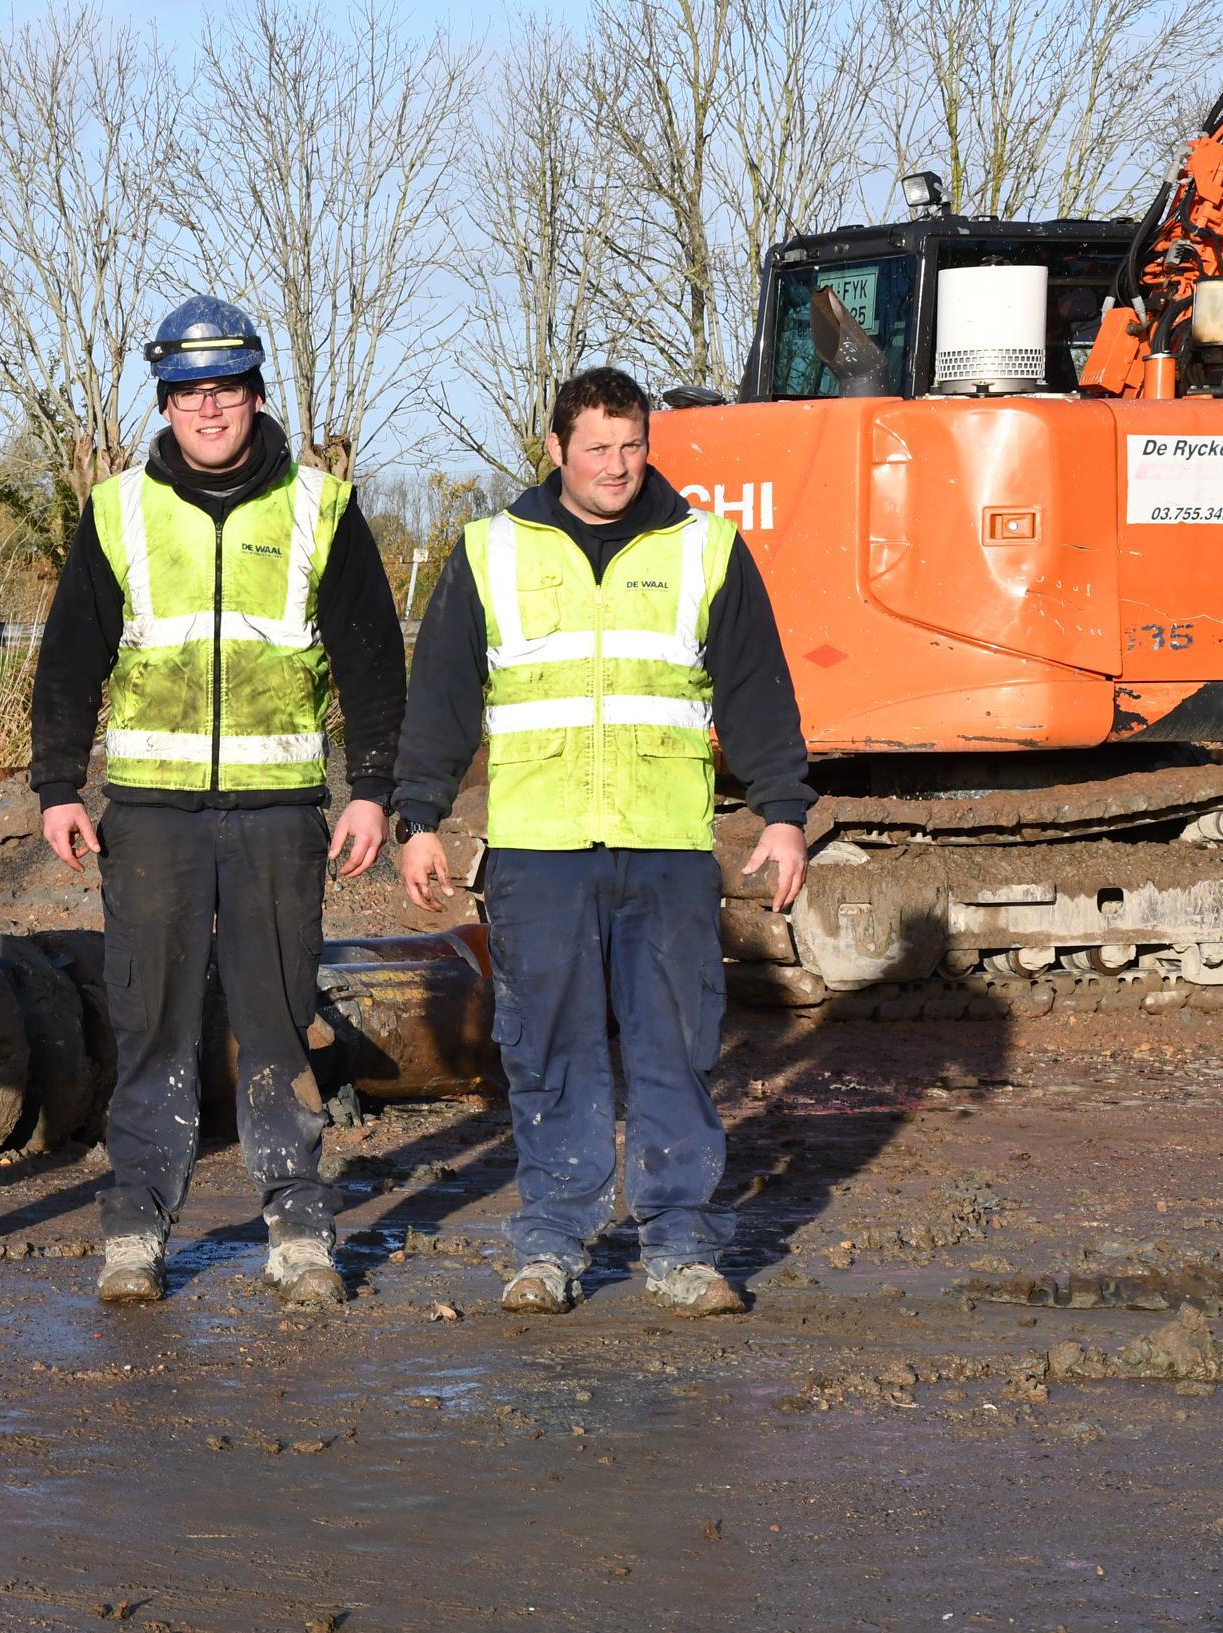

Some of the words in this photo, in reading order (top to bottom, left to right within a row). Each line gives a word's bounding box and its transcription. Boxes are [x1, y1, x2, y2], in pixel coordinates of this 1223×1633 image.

[1142, 439, 1168, 456] De
[1173, 439, 1223, 461] Ryck
[241, 543, 253, 551] DE
[255, 544, 282, 555] WAAL
[641, 580, 669, 589] WAAL
